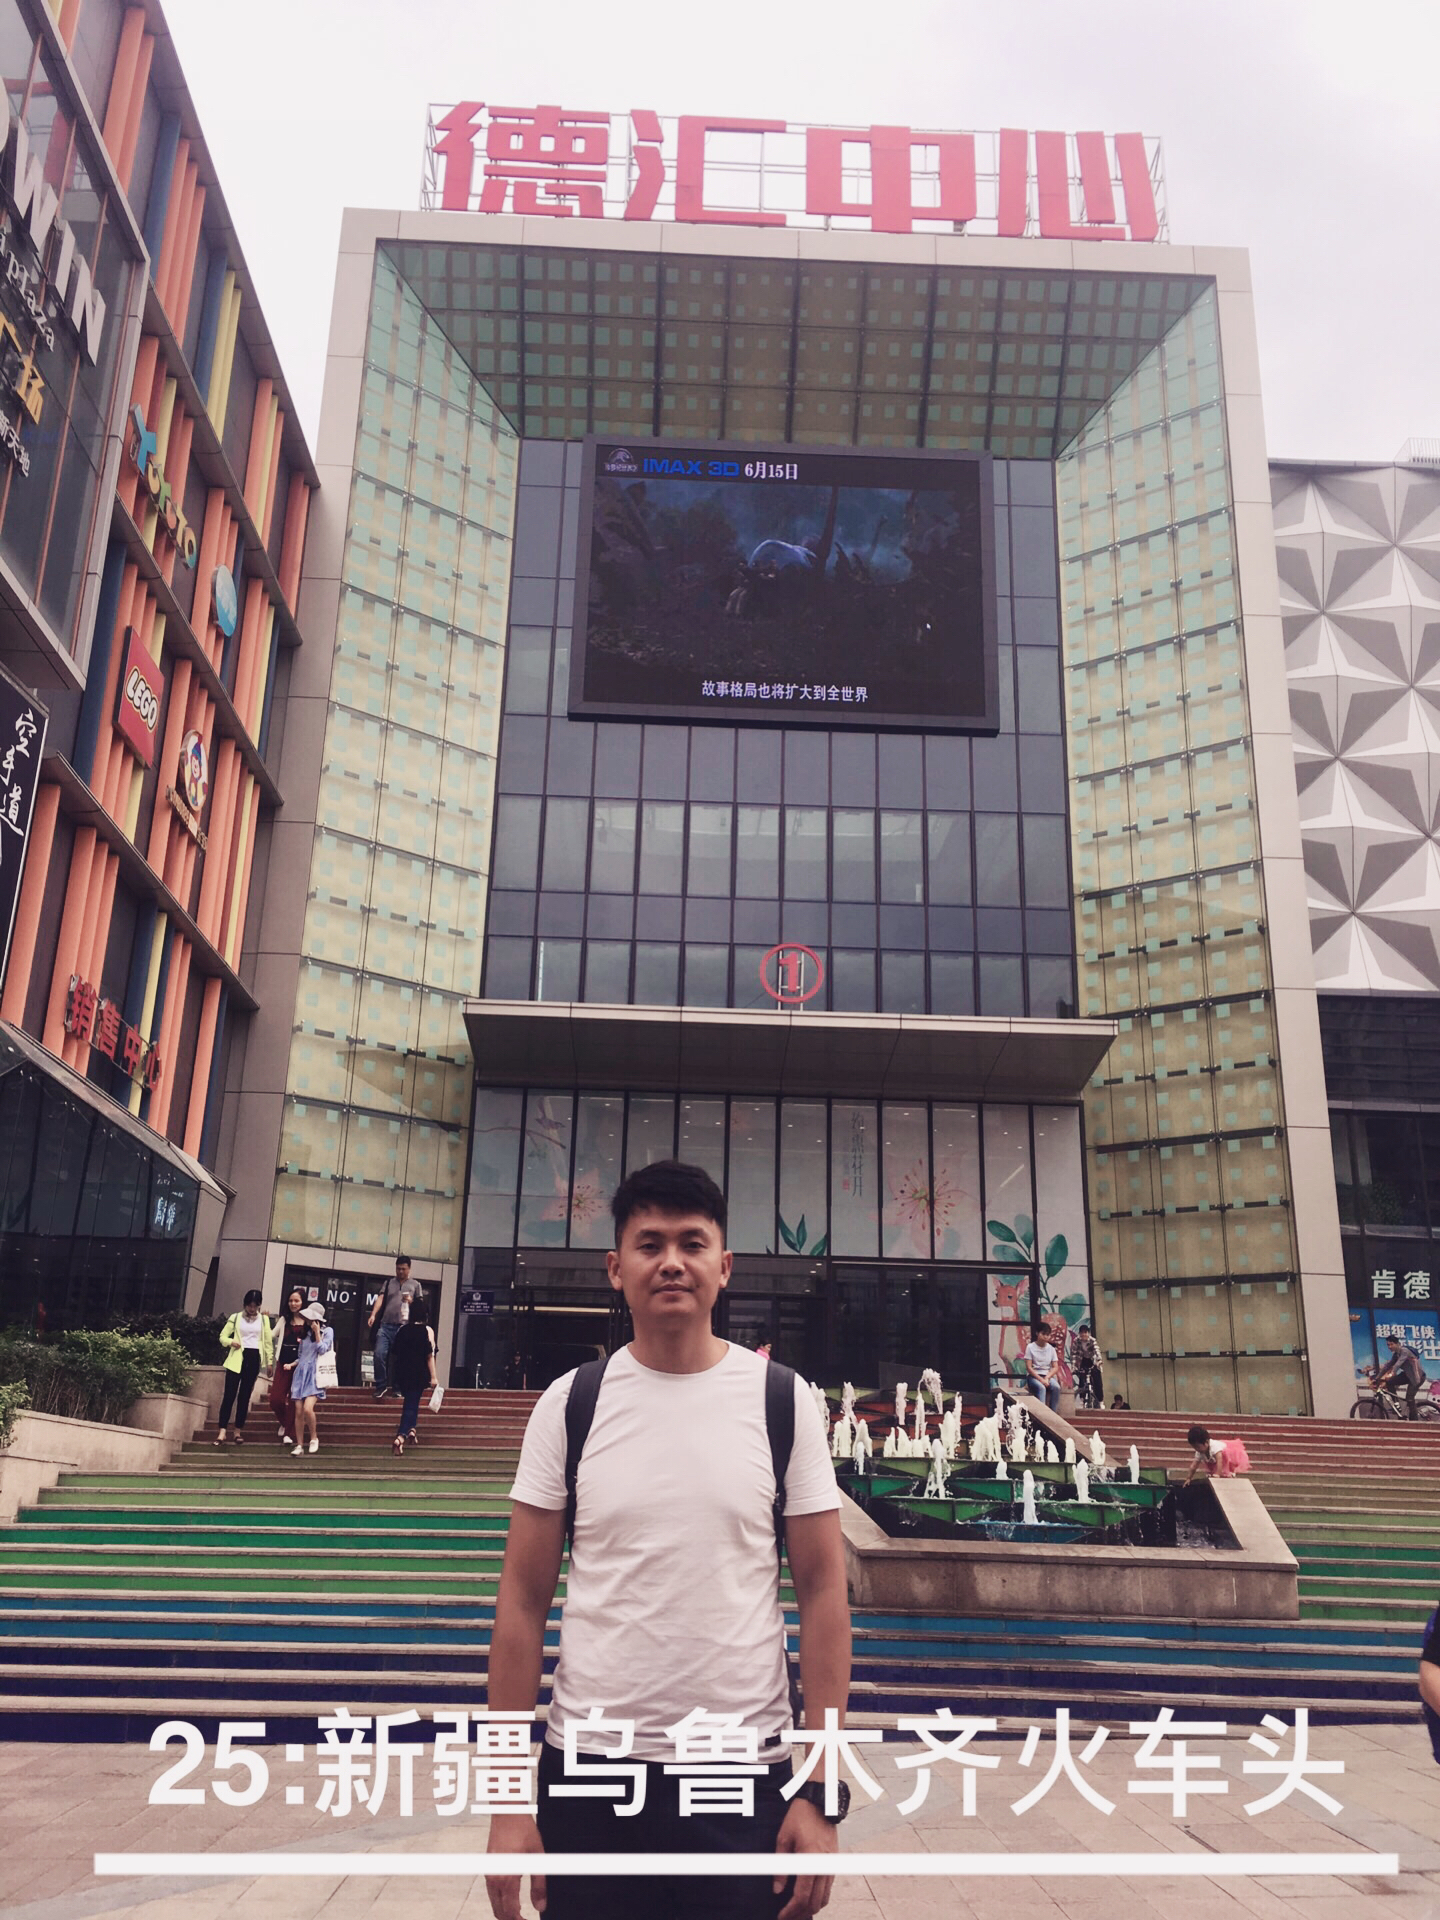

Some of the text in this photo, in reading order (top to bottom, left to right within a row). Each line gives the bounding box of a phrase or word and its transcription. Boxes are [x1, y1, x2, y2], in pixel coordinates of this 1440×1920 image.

[433, 100, 1158, 241] 德汇中心
[0, 75, 107, 367] WIN
[643, 458, 798, 480] IMAX 3D 6月15日
[126, 669, 157, 731] LEGO
[702, 680, 868, 703] 故事格局也将扩大到全世界
[65, 974, 162, 1092] 销售中心
[1371, 1268, 1431, 1300] 肯德
[1376, 1324, 1436, 1339] 超级飞侠
